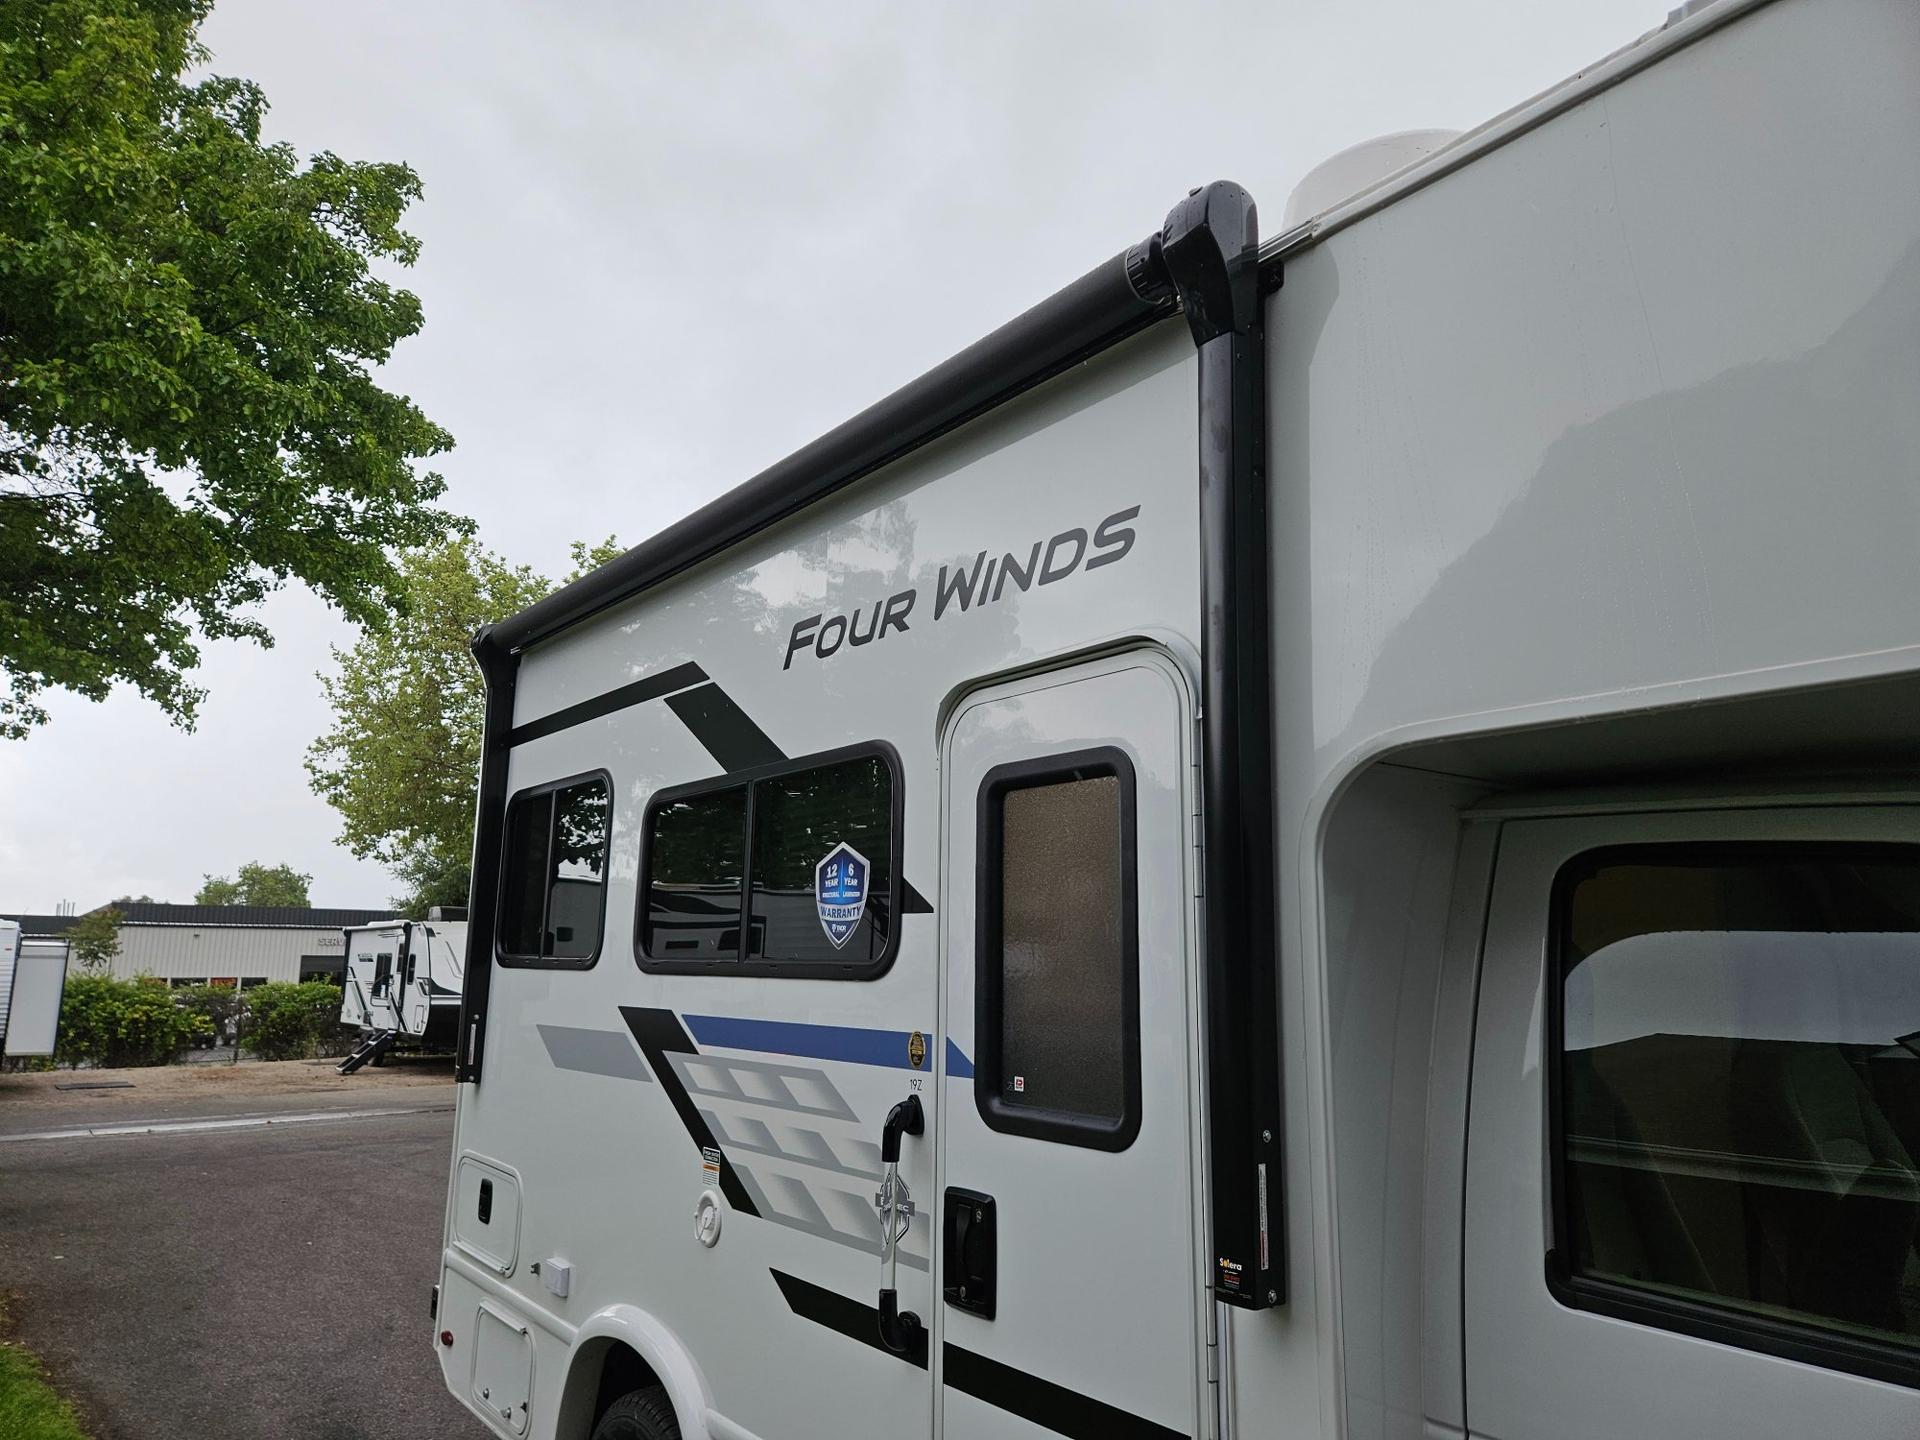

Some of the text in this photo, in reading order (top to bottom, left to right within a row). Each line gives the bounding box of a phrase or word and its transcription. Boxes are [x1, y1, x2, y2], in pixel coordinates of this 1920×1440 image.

[782, 504, 1142, 671] FOUR WINDS
[826, 863, 838, 878] 12
[848, 863, 855, 876] 6
[825, 879, 839, 888] YEAR
[844, 877, 858, 887] YEAR
[821, 904, 862, 919] WARRANTY
[909, 1079, 923, 1091] 19Z
[1219, 1257, 1243, 1271] Solera
